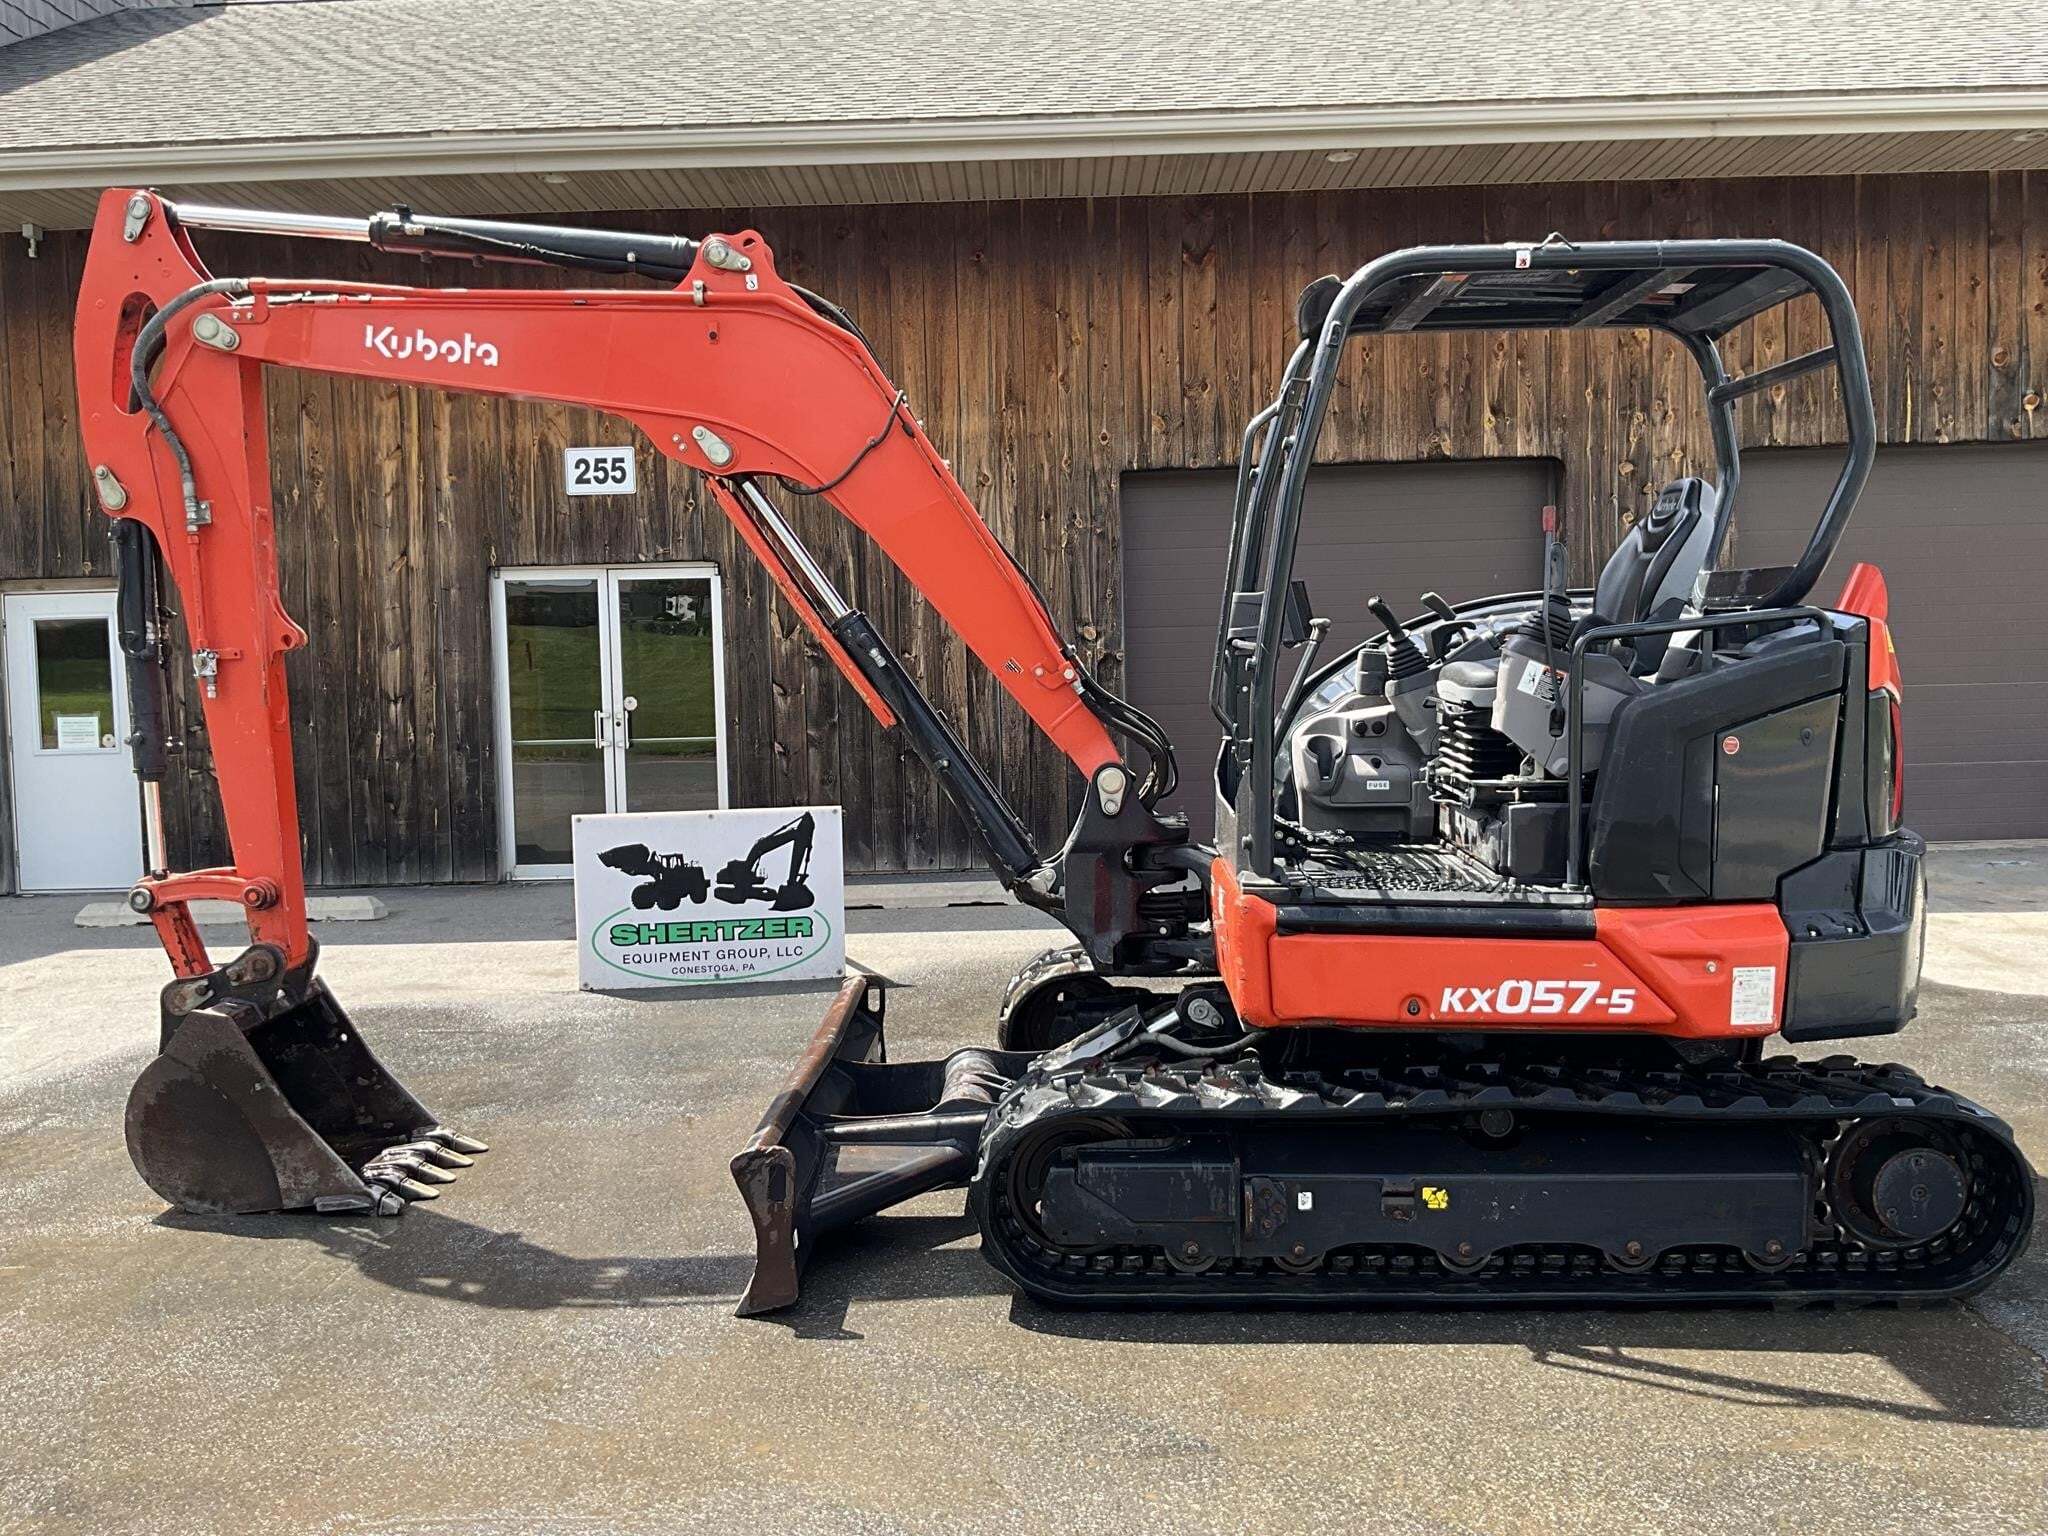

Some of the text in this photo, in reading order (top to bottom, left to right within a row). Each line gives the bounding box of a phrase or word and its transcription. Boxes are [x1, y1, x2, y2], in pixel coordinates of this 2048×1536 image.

[365, 325, 499, 367] Kubota
[574, 457, 627, 485] 255
[610, 916, 813, 946] SHERTZER
[622, 946, 804, 965] EQUIPMENT GROUP, LLC
[671, 963, 756, 975] CONESTOGA, PA
[1440, 979, 1636, 1014] KX057-5
